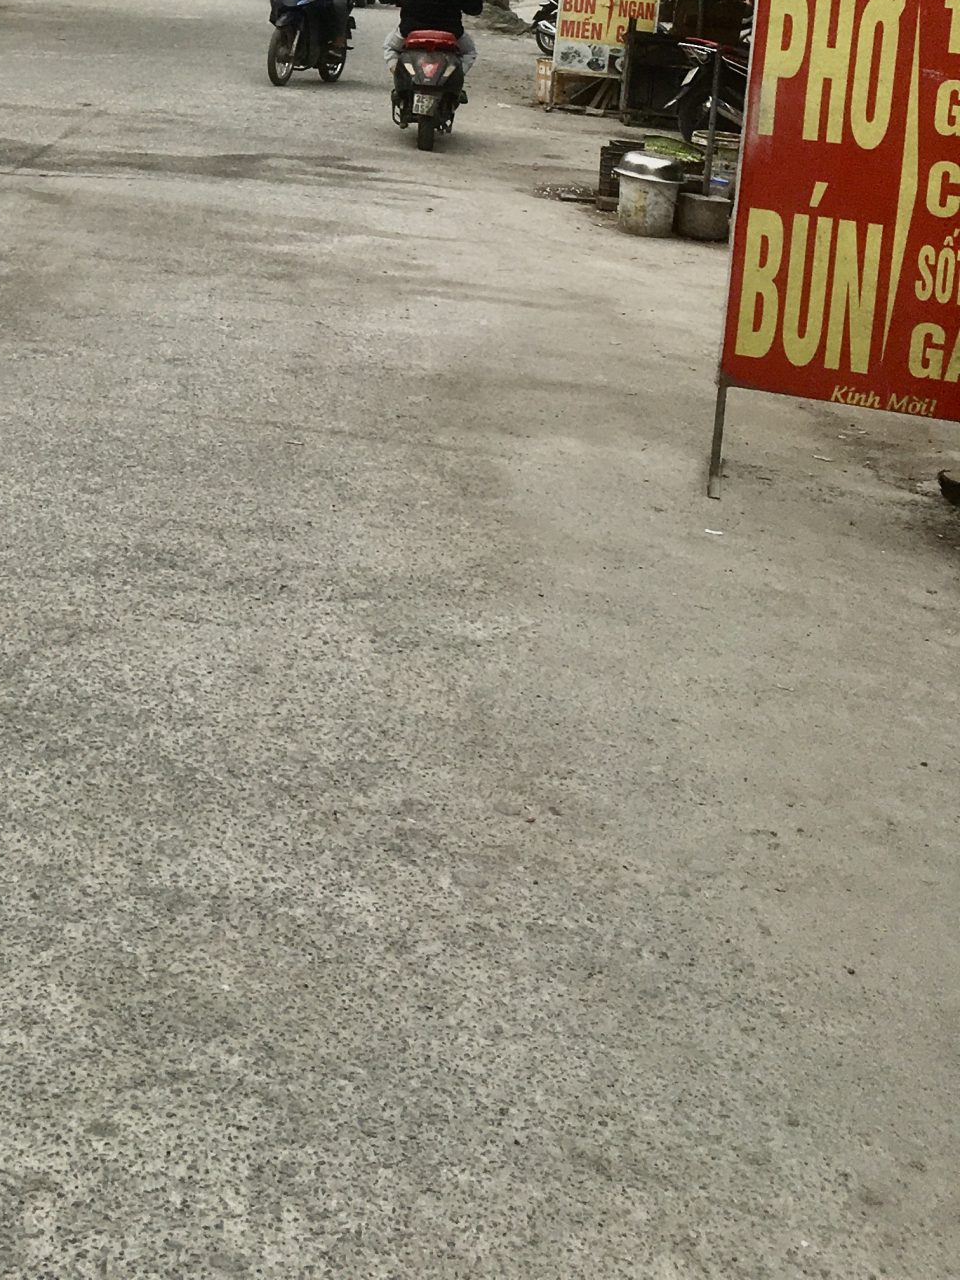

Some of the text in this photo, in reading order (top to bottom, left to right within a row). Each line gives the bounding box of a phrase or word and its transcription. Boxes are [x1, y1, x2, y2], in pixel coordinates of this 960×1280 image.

[618, 0, 655, 21] NGAN
[560, 16, 603, 41] MIẾN
[734, 181, 884, 375] BÚN
[914, 227, 960, 305] SỐ
[830, 384, 938, 417] Kính Mời!
